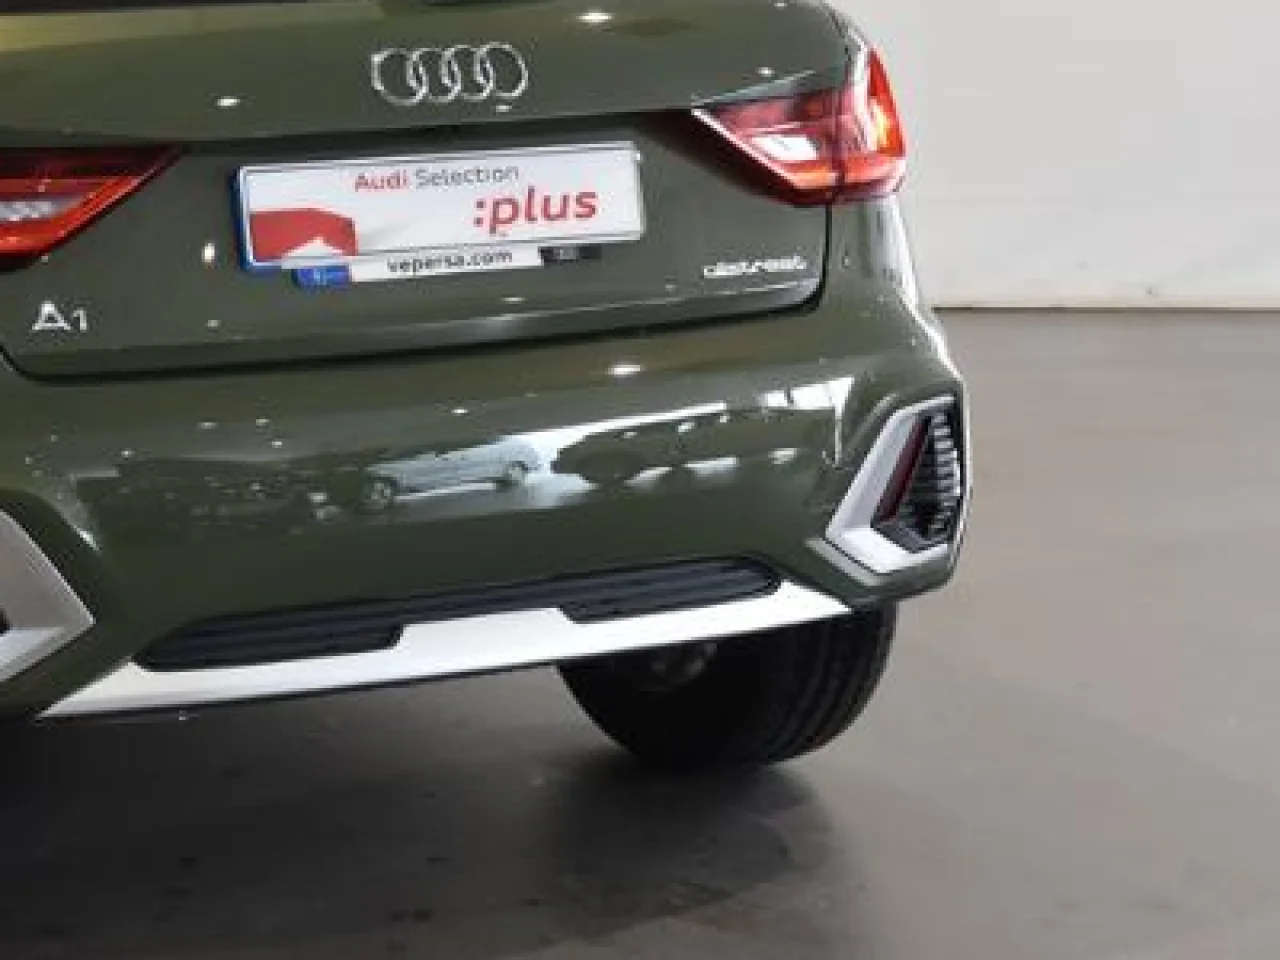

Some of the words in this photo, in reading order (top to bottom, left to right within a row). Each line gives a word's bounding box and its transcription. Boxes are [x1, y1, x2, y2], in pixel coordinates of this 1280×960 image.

[354, 169, 408, 191] Audi
[414, 164, 520, 188] Selection
[473, 185, 598, 235] :plus
[386, 250, 513, 273] vepersa.com
[31, 301, 88, 331] A1
